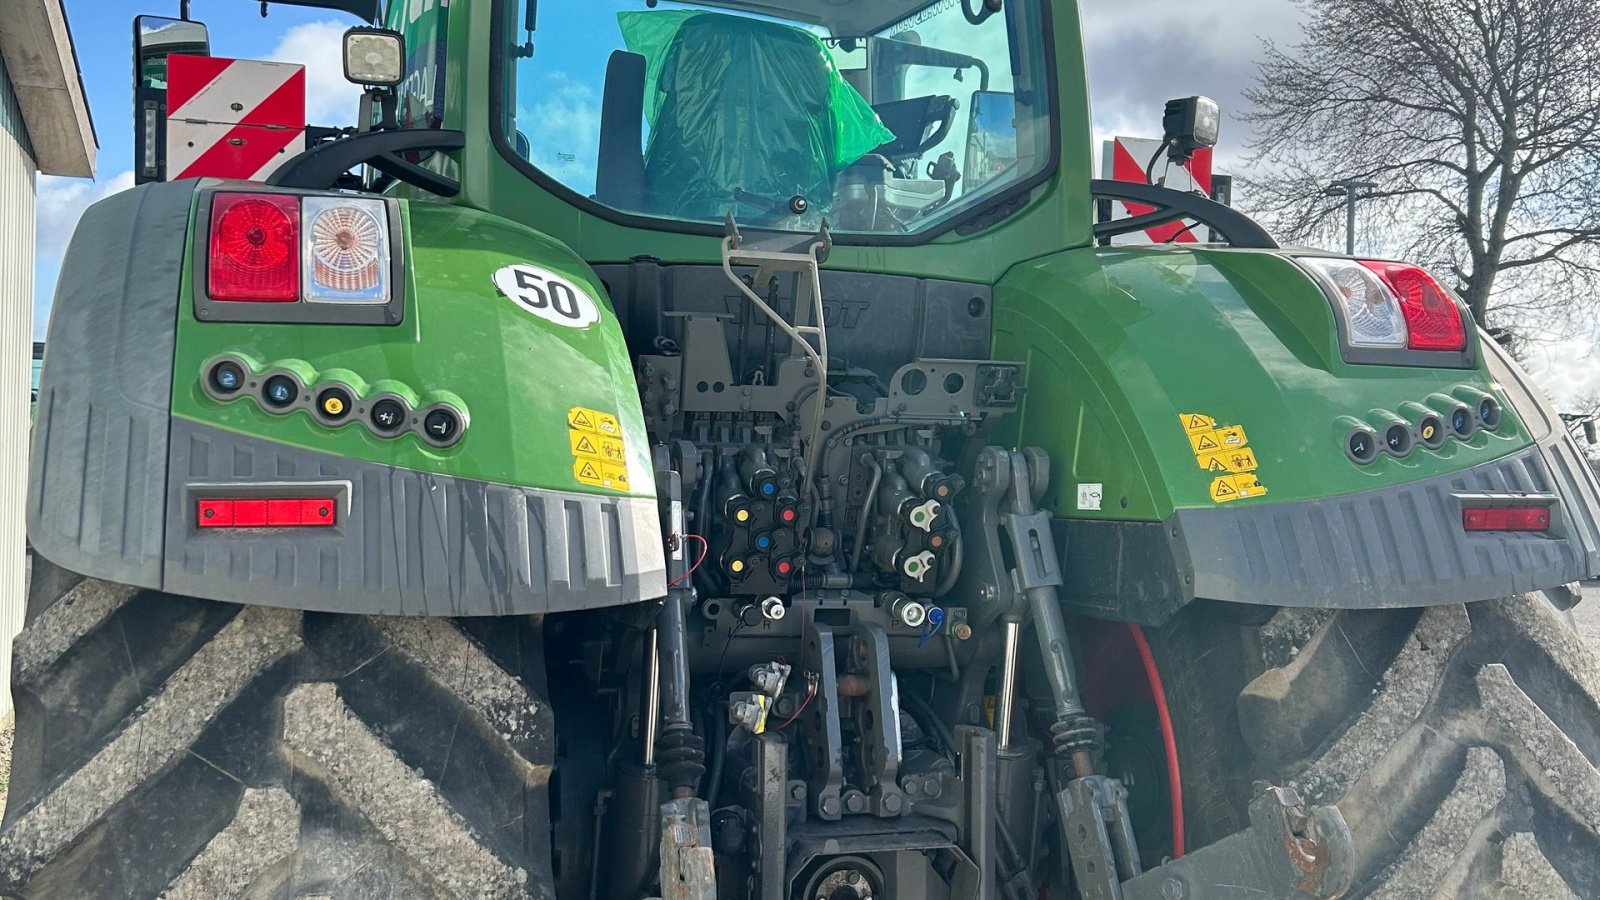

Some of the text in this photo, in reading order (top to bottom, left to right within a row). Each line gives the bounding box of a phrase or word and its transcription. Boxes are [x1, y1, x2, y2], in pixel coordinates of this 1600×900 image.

[514, 269, 581, 319] 50
[763, 620, 771, 629] R
[891, 619, 899, 629] P
